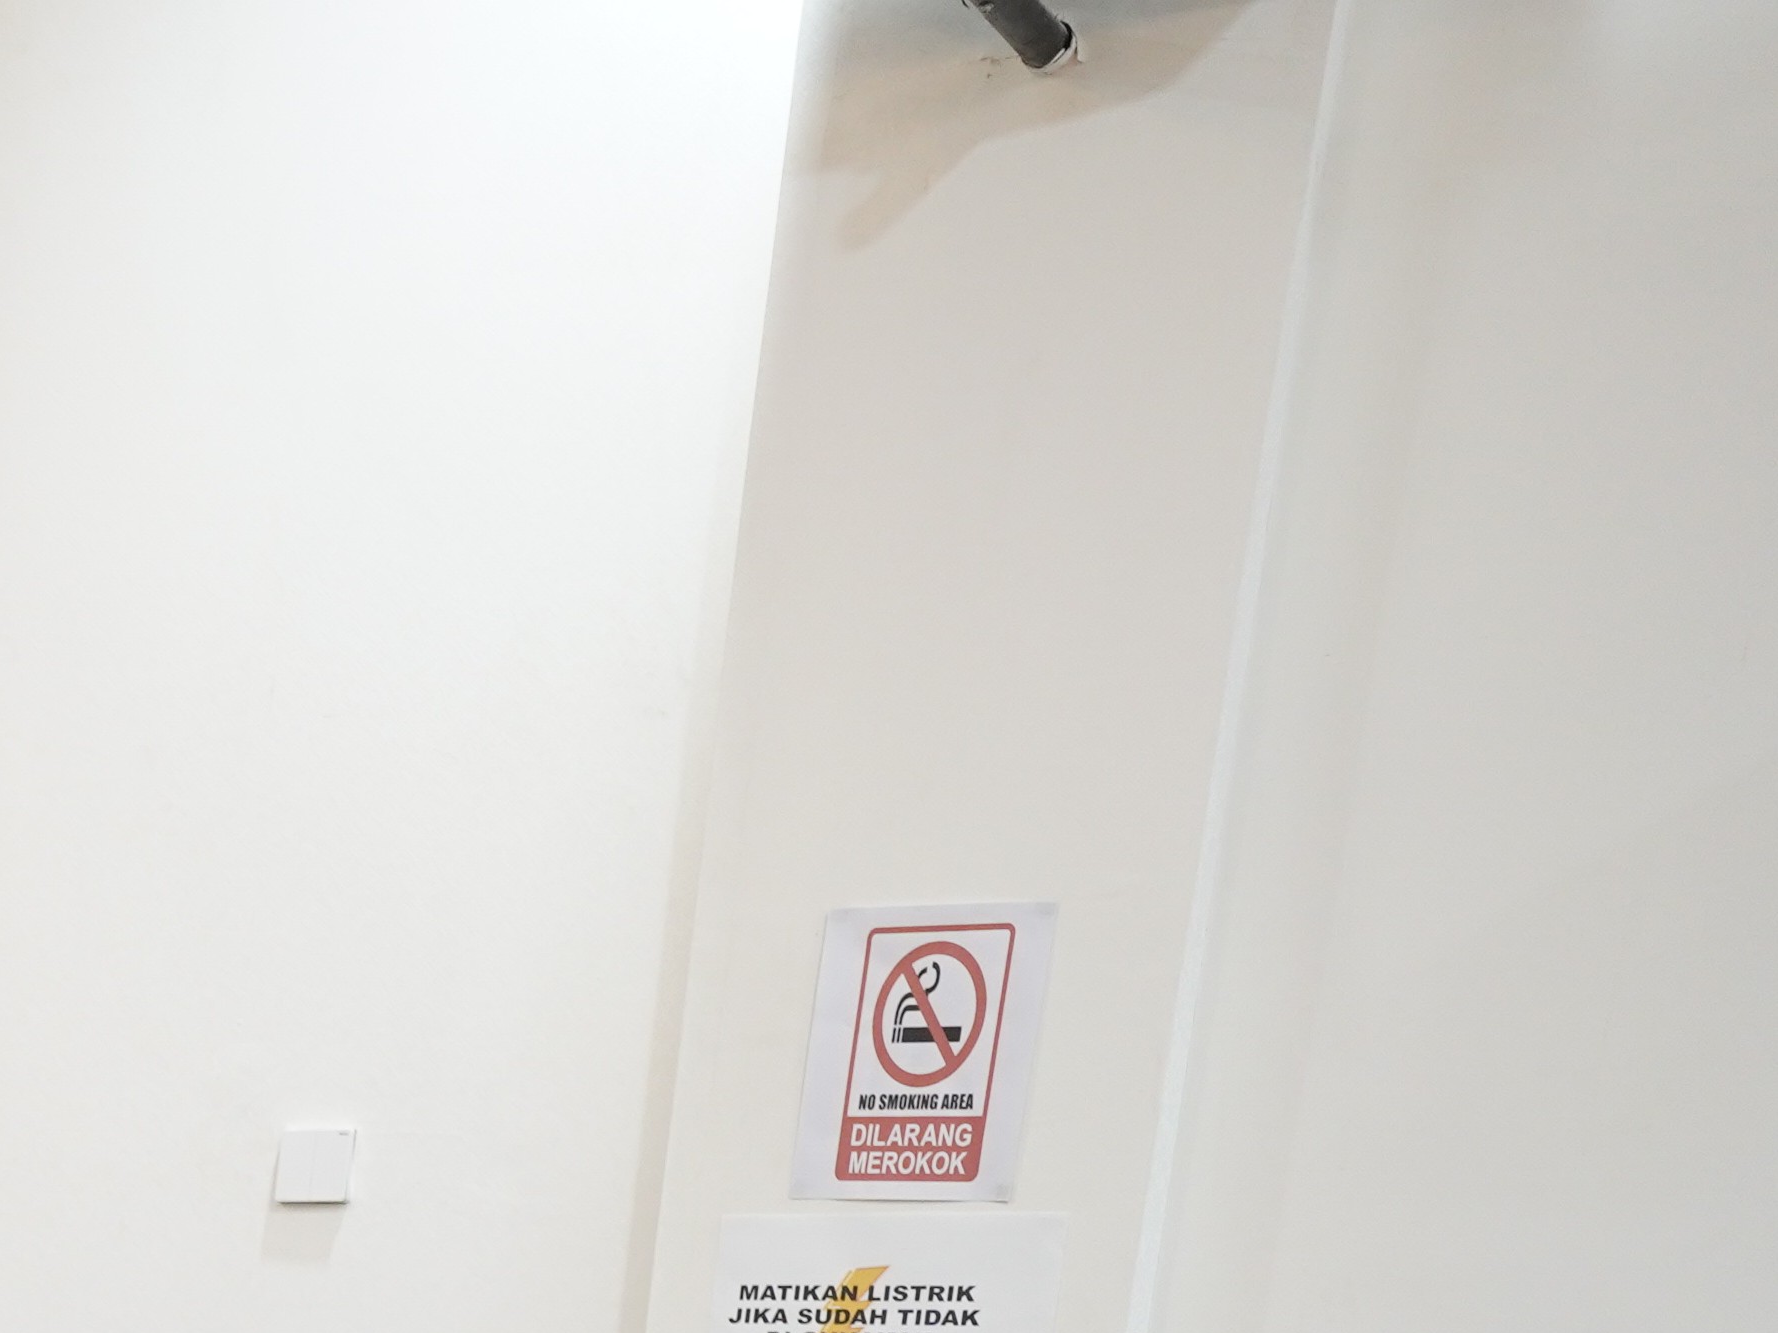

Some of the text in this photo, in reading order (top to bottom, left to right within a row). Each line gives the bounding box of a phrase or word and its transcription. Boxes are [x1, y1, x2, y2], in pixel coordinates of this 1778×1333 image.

[858, 1094, 973, 1110] NO SMOKING AREA
[851, 1123, 973, 1148] DILARANG
[848, 1151, 967, 1175] MEROKOK
[739, 1285, 976, 1302] MATIKAN LISTRIK
[729, 1308, 980, 1326] JIKA SUDAH TIDAK
